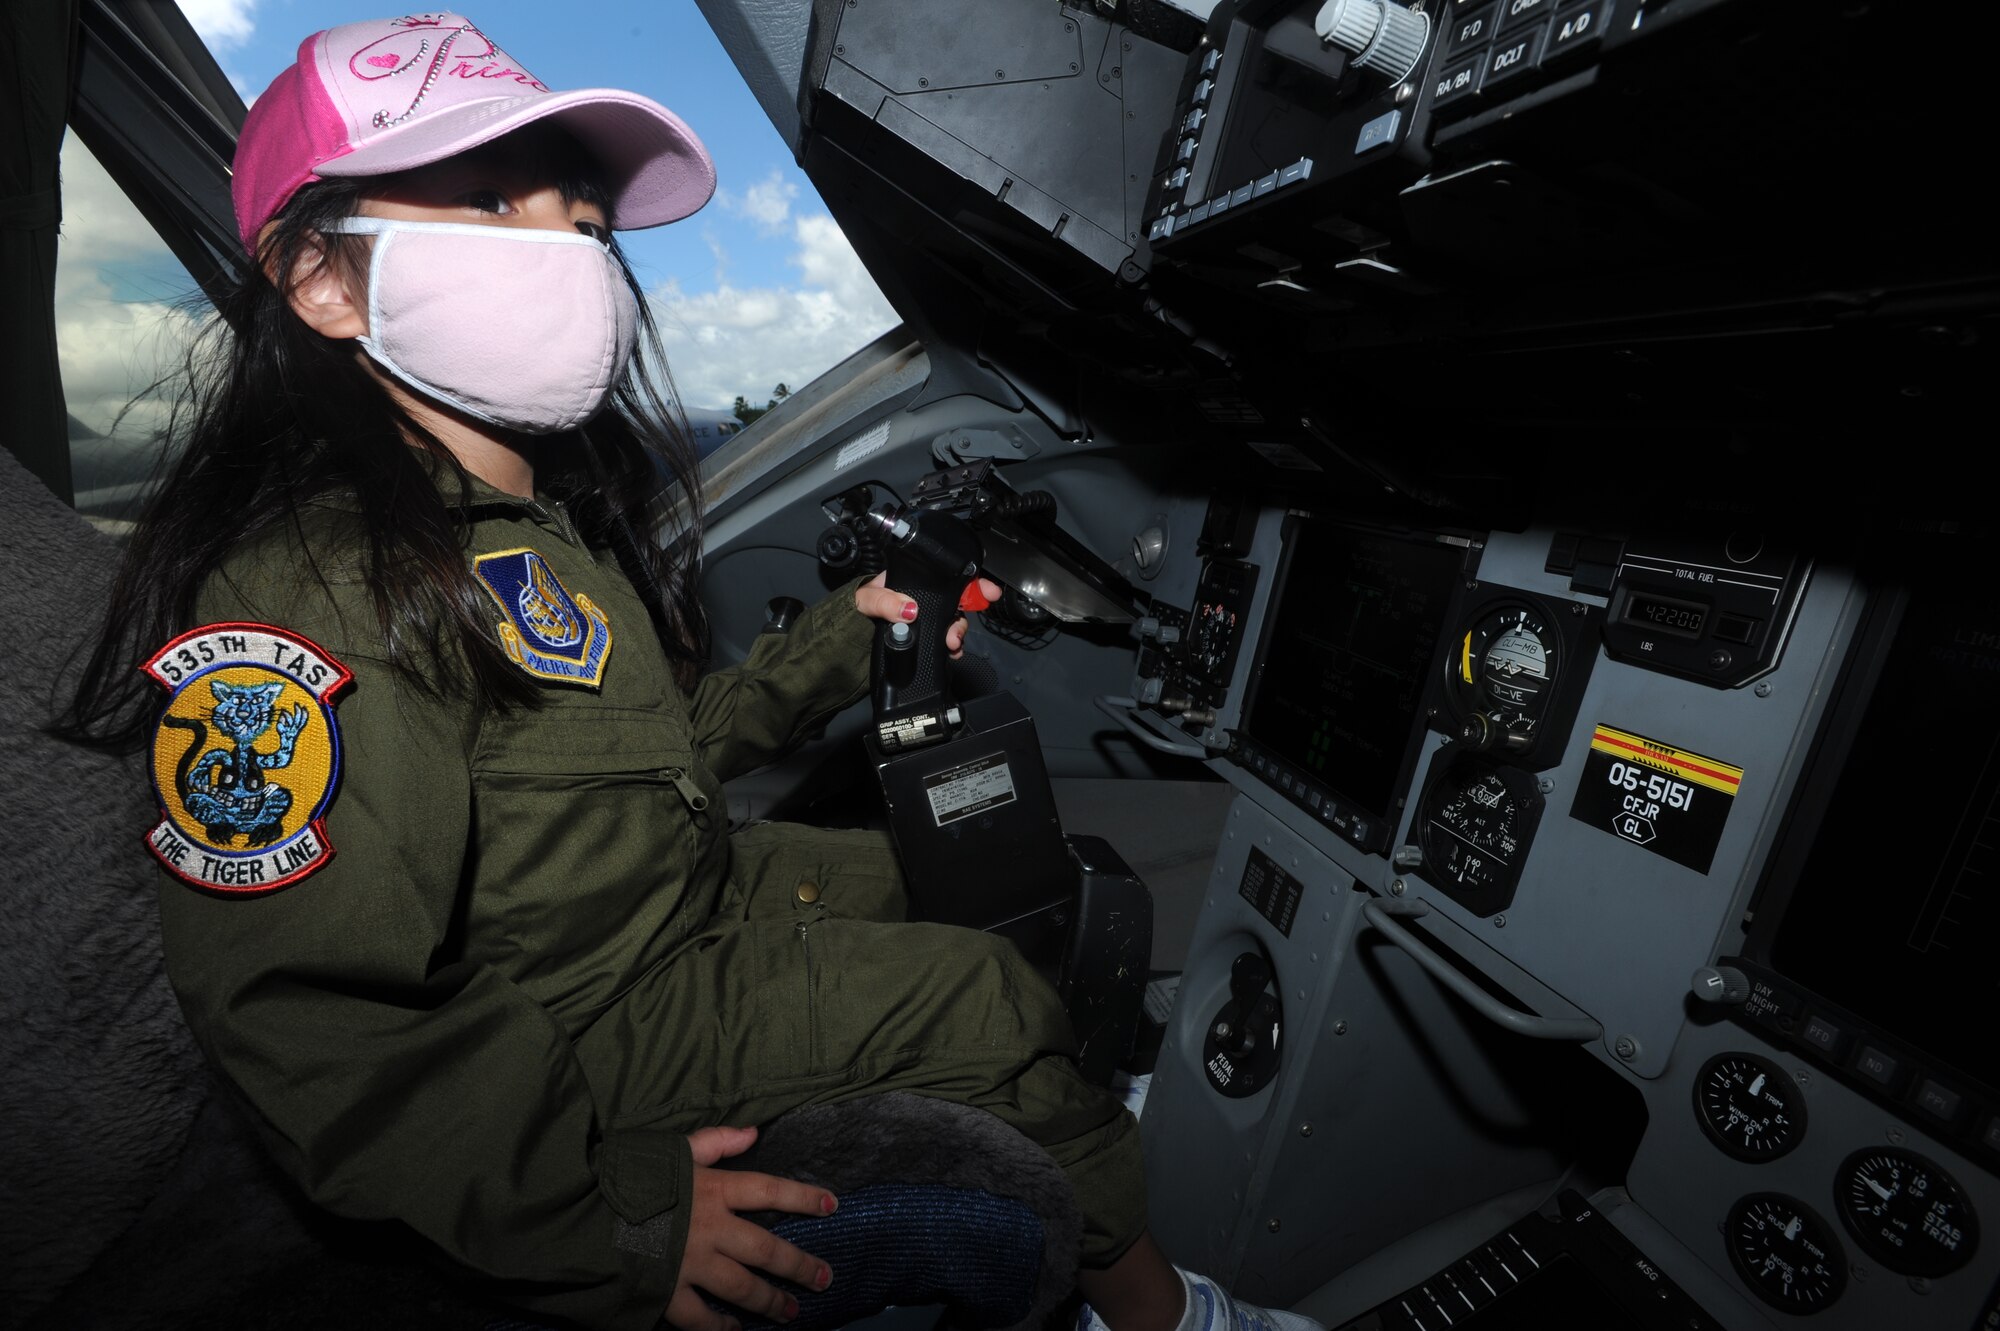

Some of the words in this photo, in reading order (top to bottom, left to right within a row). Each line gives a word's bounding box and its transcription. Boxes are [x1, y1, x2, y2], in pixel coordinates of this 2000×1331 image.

[1461, 19, 1482, 42] F/D
[1557, 12, 1591, 42] A/D
[1493, 43, 1527, 72] DCLT
[1435, 69, 1472, 98] RA/BA
[1674, 569, 1696, 580] TOTAL
[1698, 573, 1715, 584] FUEL
[1646, 605, 1702, 630] 42200
[1641, 641, 1654, 652] LBS
[273, 641, 329, 686] TAS
[527, 651, 573, 675] PACIFIC
[580, 660, 597, 680] AIR
[880, 721, 894, 729] GRIP
[1608, 762, 1695, 812] 05-5151
[1622, 795, 1660, 821] CFJR
[1475, 817, 1486, 827] ALT
[1623, 818, 1642, 838] GL
[155, 827, 190, 867] THE
[201, 855, 265, 885] TIGER
[273, 834, 318, 876] LINE
[1471, 858, 1481, 868] 60
[1447, 863, 1458, 874] IAS
[1753, 982, 1774, 998] DAY
[1745, 1001, 1764, 1017] OFF
[1750, 992, 1781, 1015] NIGHT
[1809, 1024, 1830, 1043] PFD
[1207, 1059, 1231, 1087] ADJUST
[1216, 1052, 1234, 1078] PEDAL
[1866, 1057, 1884, 1074] ND
[1723, 1079, 1732, 1089] 5
[1733, 1072, 1745, 1085] AIL
[1764, 1091, 1783, 1110] TRIM
[1728, 1103, 1749, 1122] WING
[1749, 1119, 1763, 1133] DN
[1728, 1113, 1739, 1125] 10
[1762, 1117, 1770, 1127] R
[1744, 1124, 1755, 1136] 10
[1890, 1168, 1900, 1180] 5
[1911, 1175, 1928, 1190] 10
[1907, 1185, 1924, 1198] UP
[1872, 1205, 1881, 1217] 5
[1757, 1220, 1766, 1231] 5
[1922, 1220, 1958, 1251] TRIM
[1924, 1211, 1962, 1241] STAB
[1766, 1213, 1787, 1232] RUD
[1801, 1238, 1825, 1260] TRIM
[1881, 1227, 1904, 1248] DEG
[1634, 1259, 1660, 1281] MSG
[1764, 1257, 1776, 1271] 10
[1769, 1252, 1794, 1274] NOSE
[1800, 1265, 1809, 1276] R
[1781, 1271, 1793, 1284] 10
